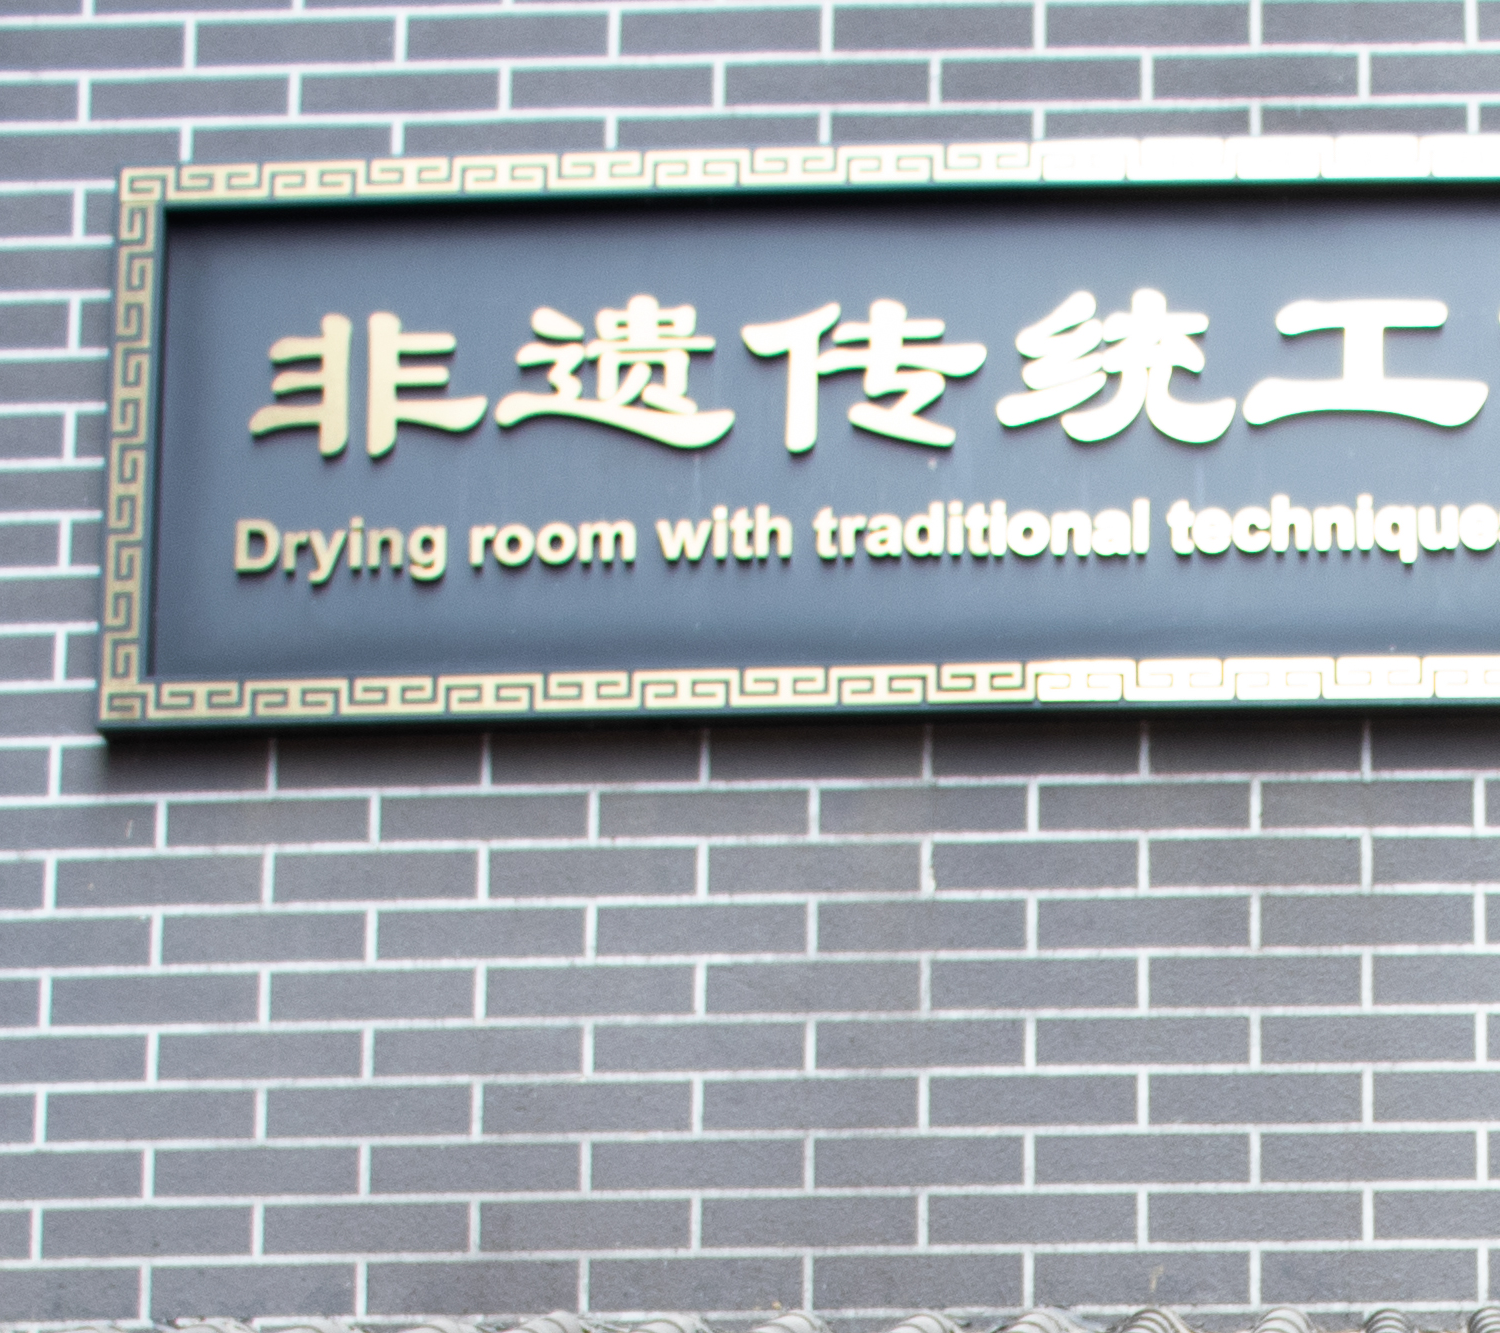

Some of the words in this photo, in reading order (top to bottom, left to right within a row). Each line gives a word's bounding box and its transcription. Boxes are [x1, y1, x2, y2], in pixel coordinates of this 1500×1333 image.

[234, 517, 447, 581] Drying
[469, 518, 636, 565] room
[655, 502, 792, 558] with
[812, 497, 1151, 557] traditional
